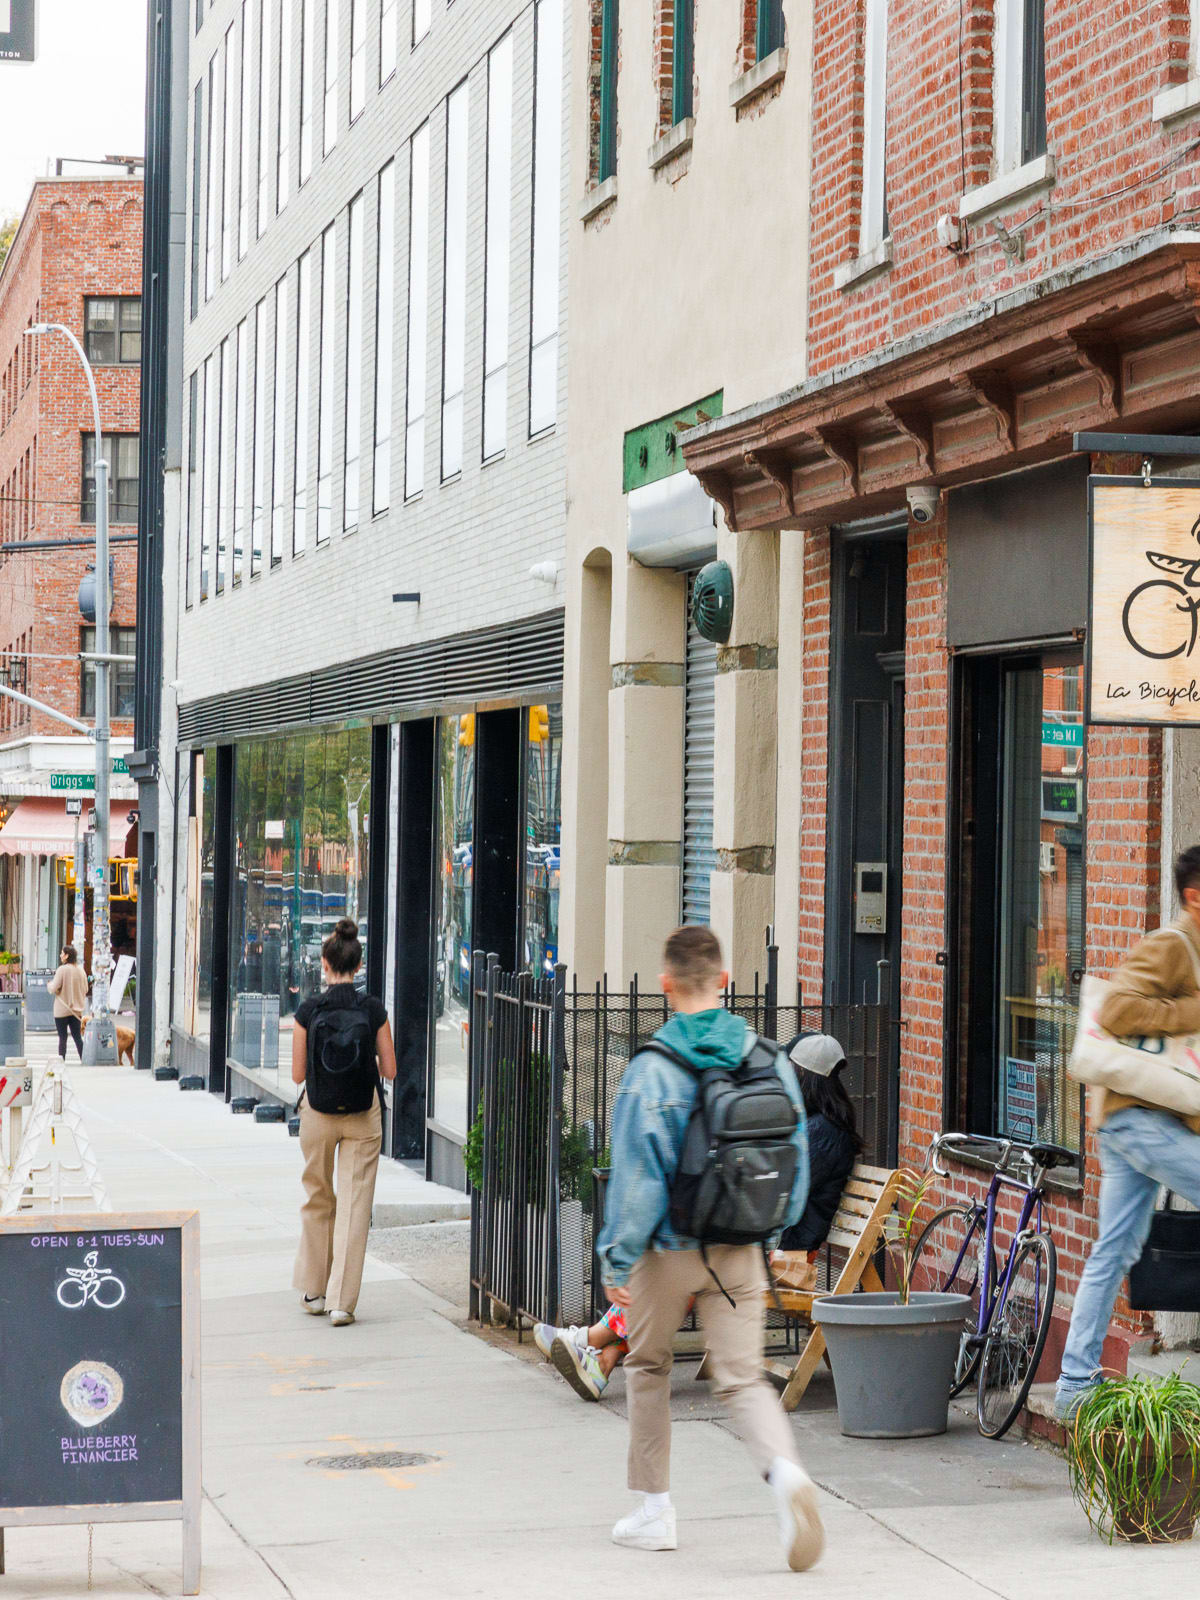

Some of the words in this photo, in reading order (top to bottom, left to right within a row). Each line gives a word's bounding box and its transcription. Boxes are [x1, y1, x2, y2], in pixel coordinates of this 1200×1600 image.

[1106, 683, 1131, 699] La
[51, 775, 83, 789] Driggs
[31, 1236, 69, 1247] OPEN
[61, 1435, 137, 1450] BLUEBERRY
[62, 1448, 138, 1464] FINANCIER
